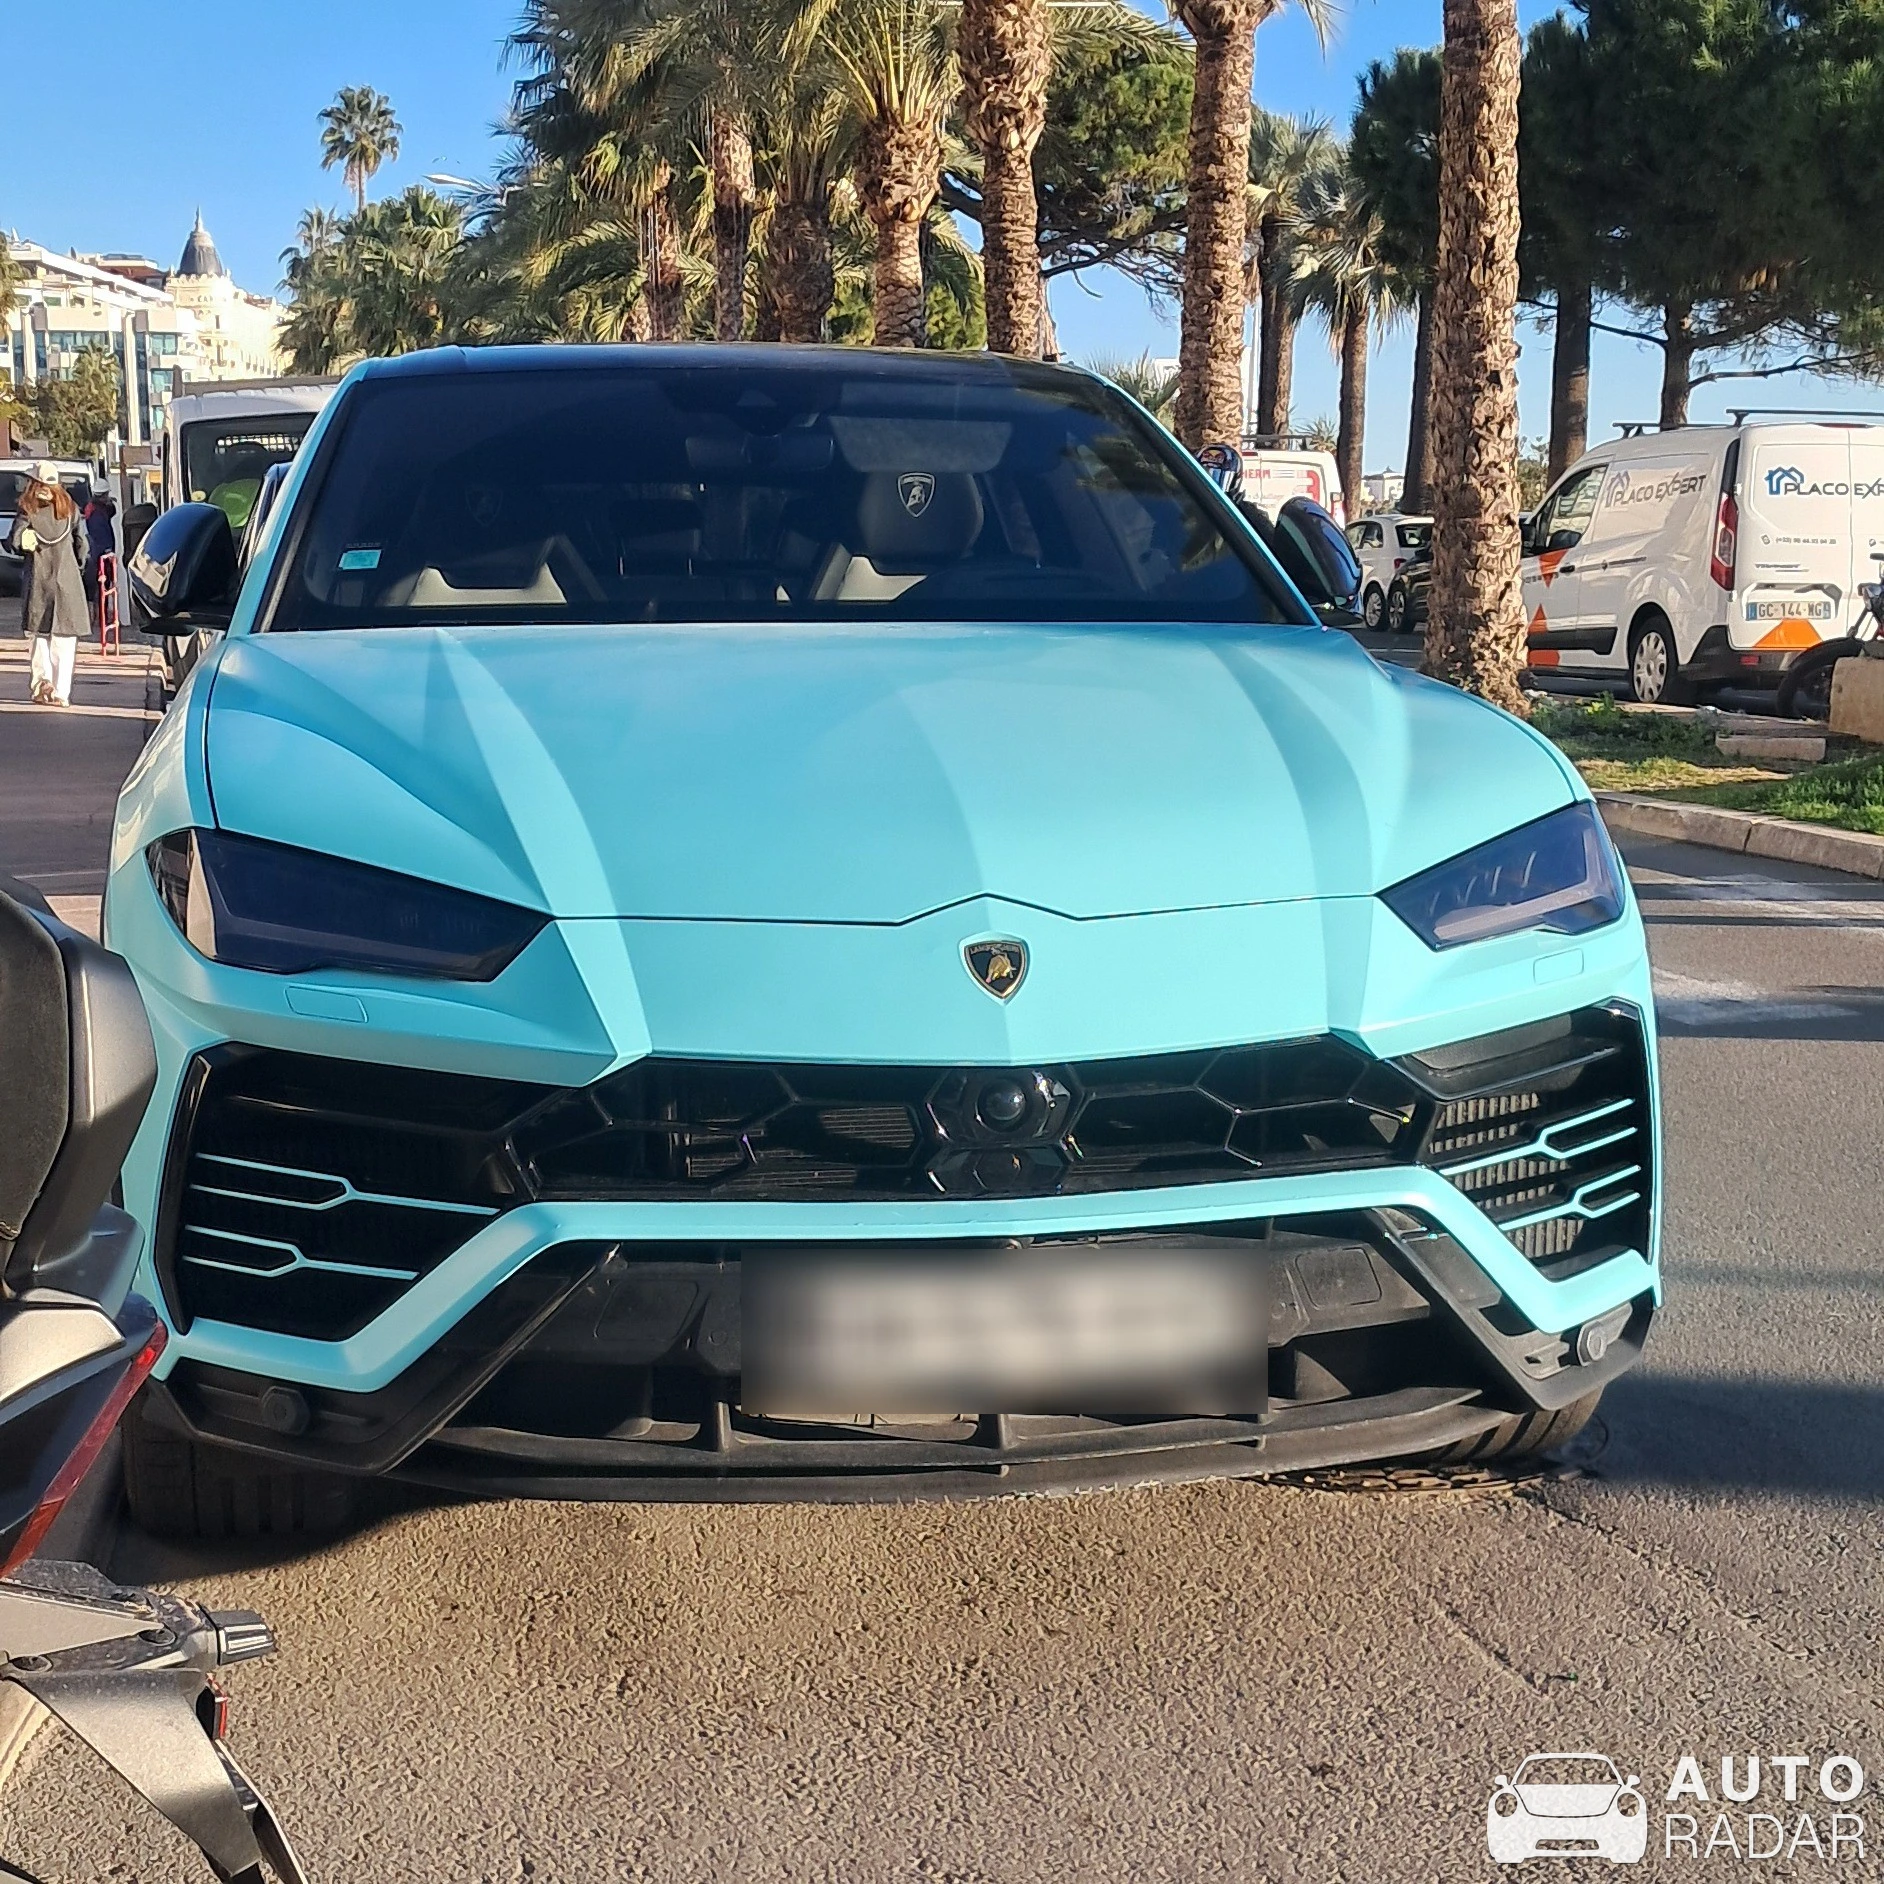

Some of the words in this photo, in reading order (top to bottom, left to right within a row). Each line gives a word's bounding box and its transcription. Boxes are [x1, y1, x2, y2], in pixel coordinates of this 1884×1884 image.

[1613, 484, 1654, 507] PLACO
[1655, 471, 1707, 503] EXPERT
[1784, 482, 1850, 496] PLACO
